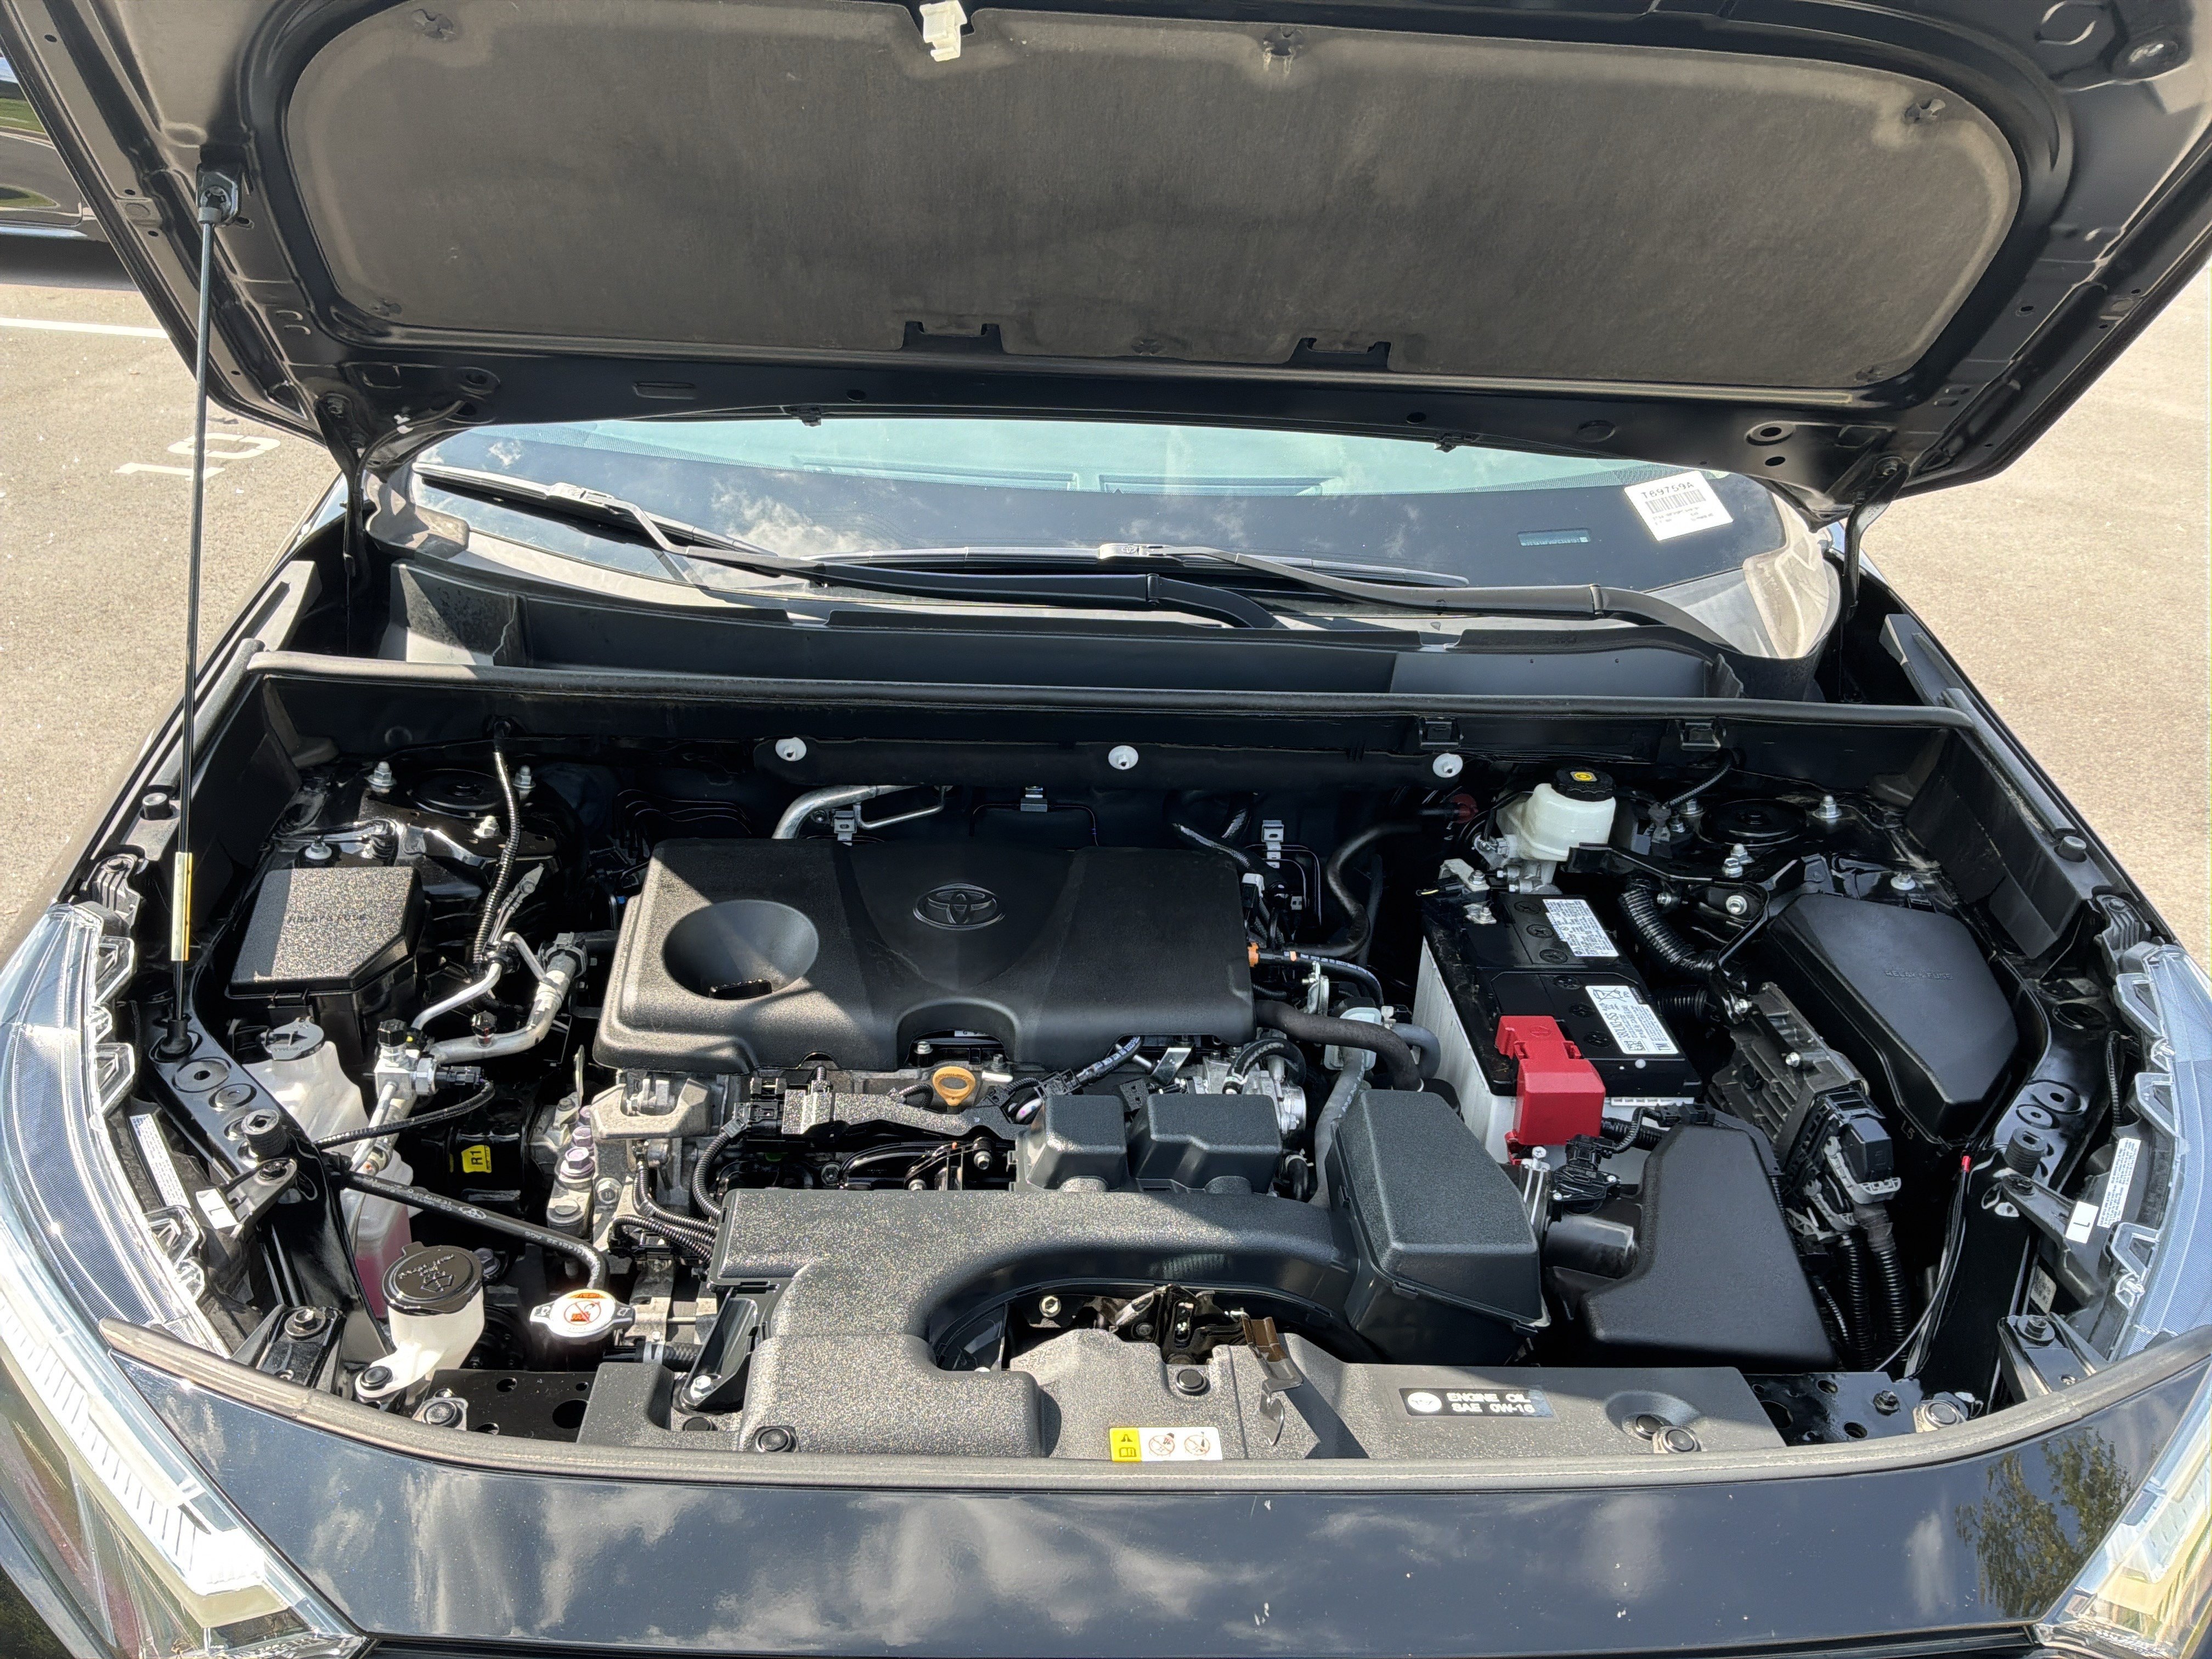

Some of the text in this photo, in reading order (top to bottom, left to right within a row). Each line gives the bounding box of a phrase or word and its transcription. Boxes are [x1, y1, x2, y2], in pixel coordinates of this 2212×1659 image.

[470, 1150, 483, 1165] R1
[1446, 1392, 1532, 1403] ENGINE OIL
[1451, 1403, 1536, 1413] SAE 0W-16
